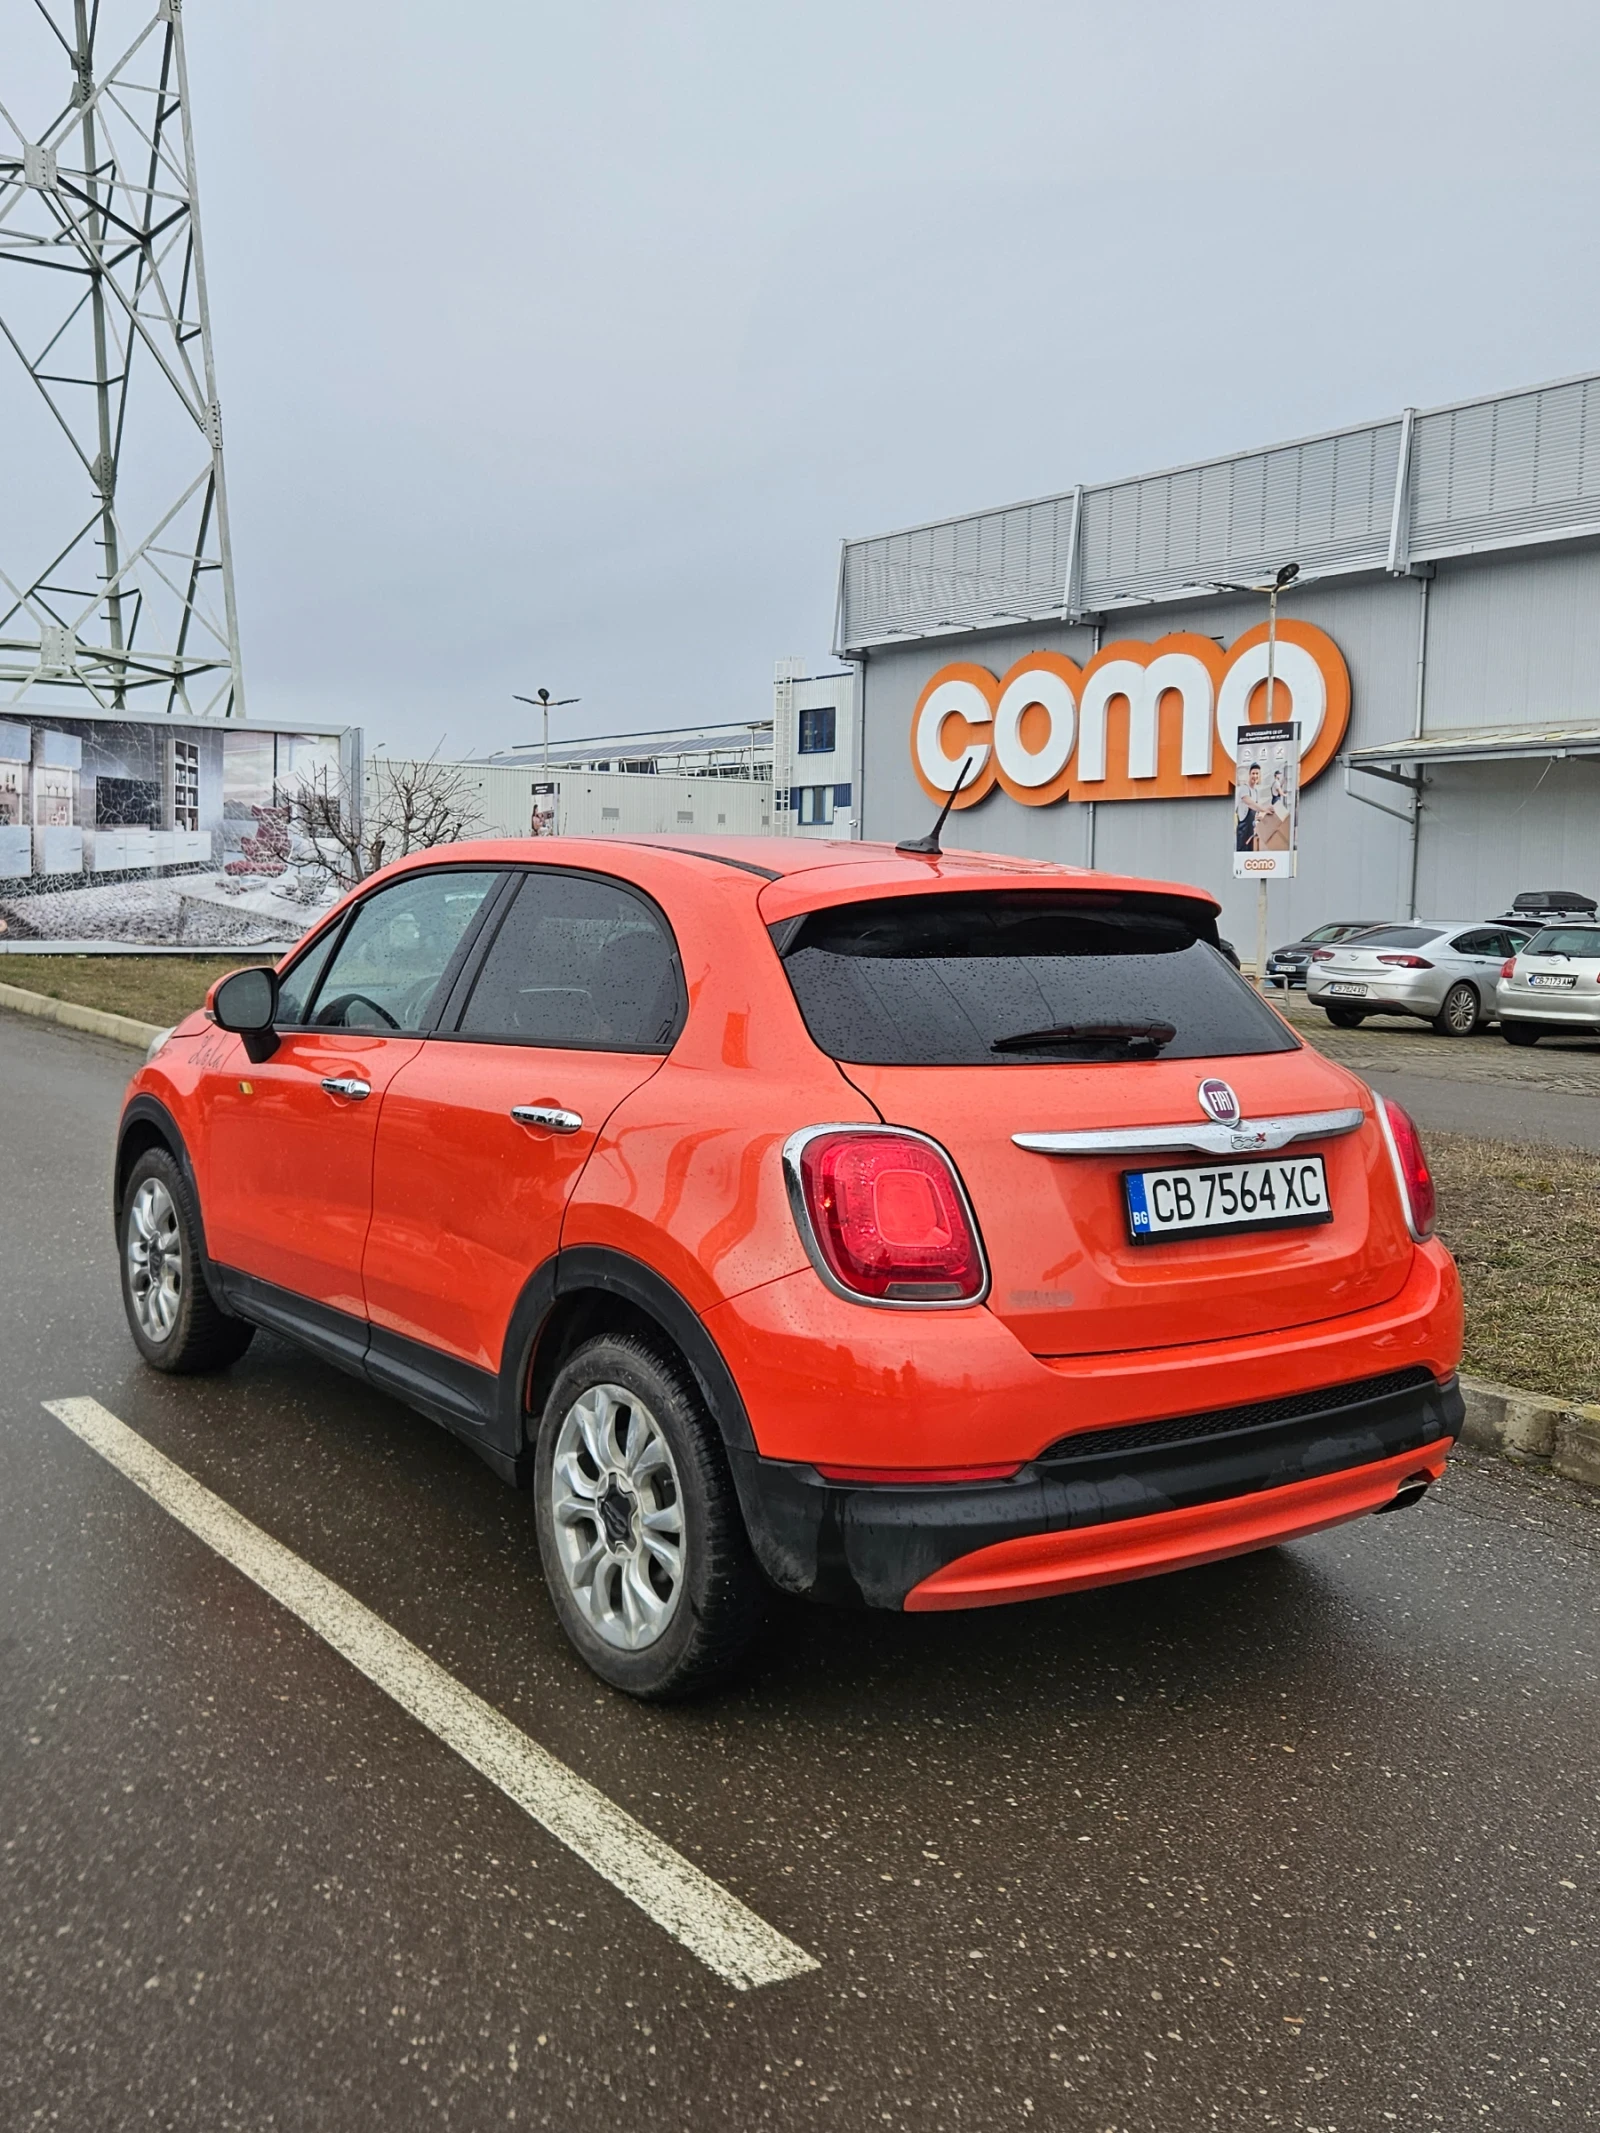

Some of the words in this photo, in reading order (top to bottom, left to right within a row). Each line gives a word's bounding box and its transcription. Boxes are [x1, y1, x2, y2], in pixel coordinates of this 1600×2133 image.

[917, 640, 1327, 791] como
[1244, 859, 1275, 870] como
[1208, 1091, 1233, 1111] FIAT
[1152, 1177, 1195, 1222] CB
[1199, 1169, 1276, 1218] 7564
[1279, 1165, 1321, 1209] XC
[1133, 1211, 1148, 1225] BG
